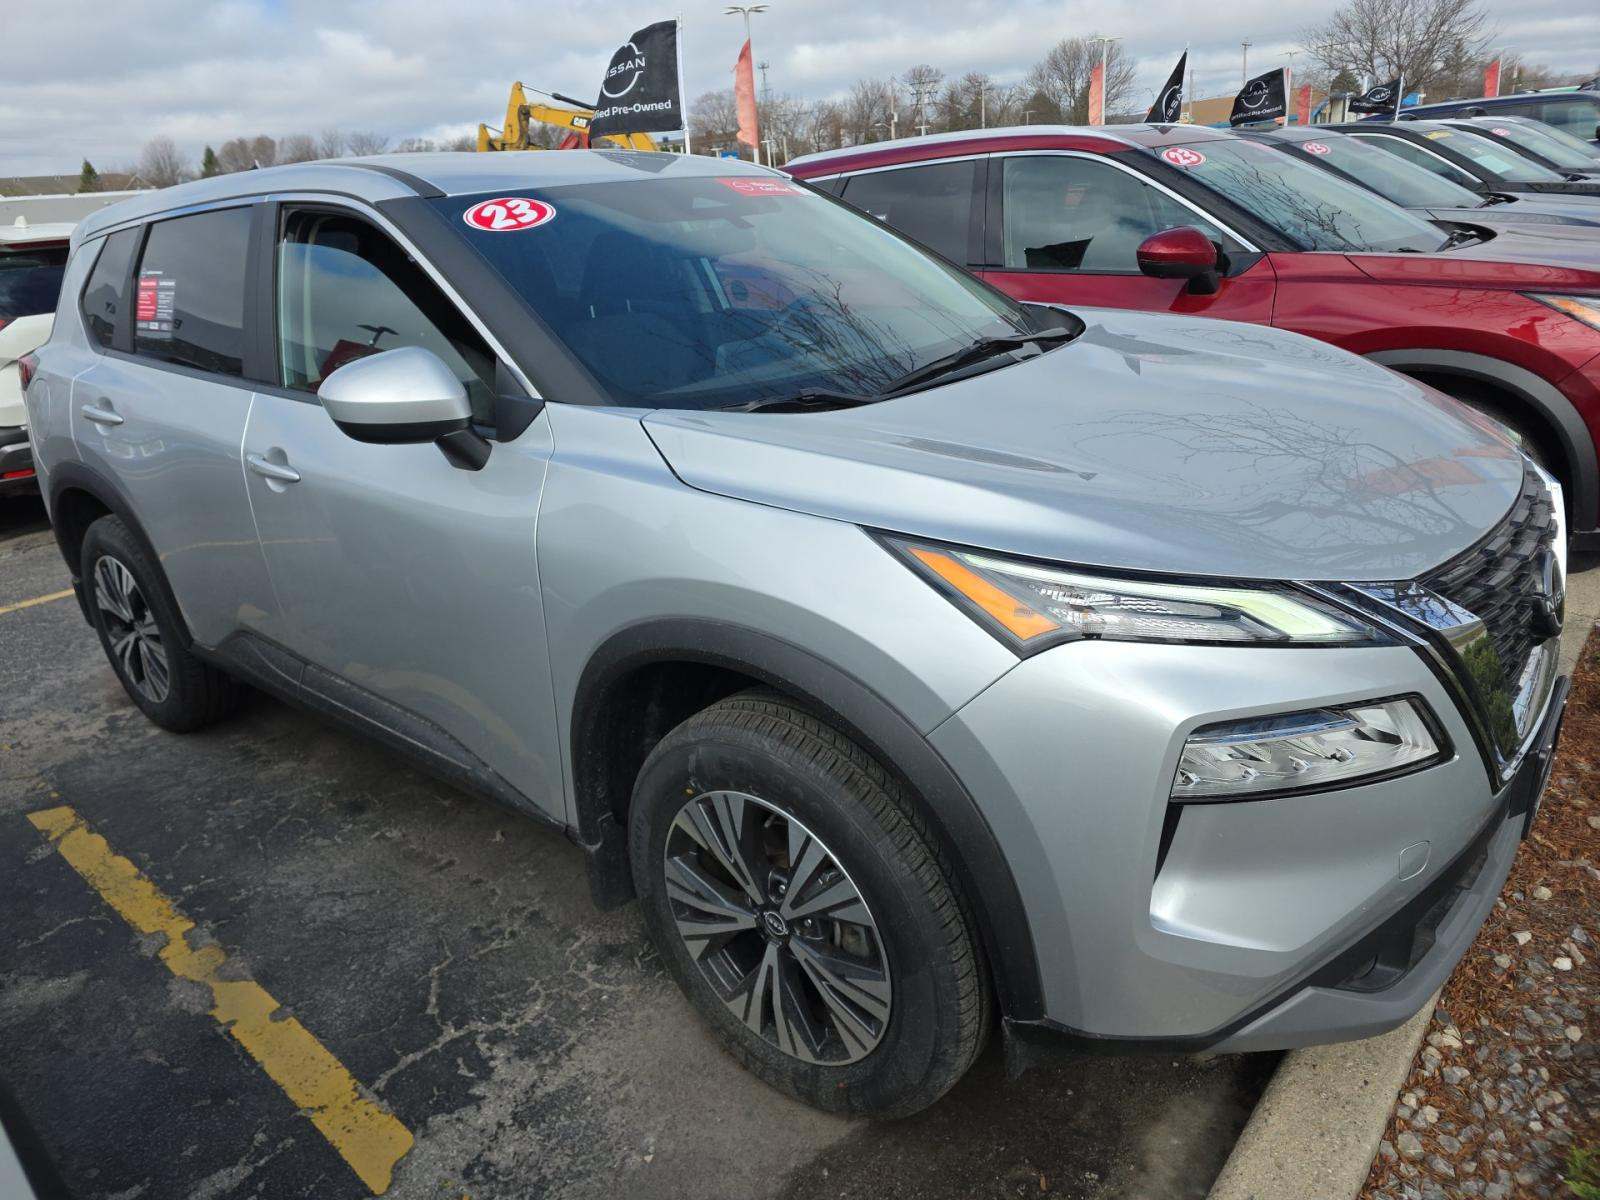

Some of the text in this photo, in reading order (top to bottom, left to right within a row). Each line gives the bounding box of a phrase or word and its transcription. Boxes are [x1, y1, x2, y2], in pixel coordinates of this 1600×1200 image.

[606, 56, 646, 79] ISSAN
[611, 99, 673, 116] Pre-Owned
[1168, 148, 1200, 165] 23
[481, 198, 539, 229] 23
